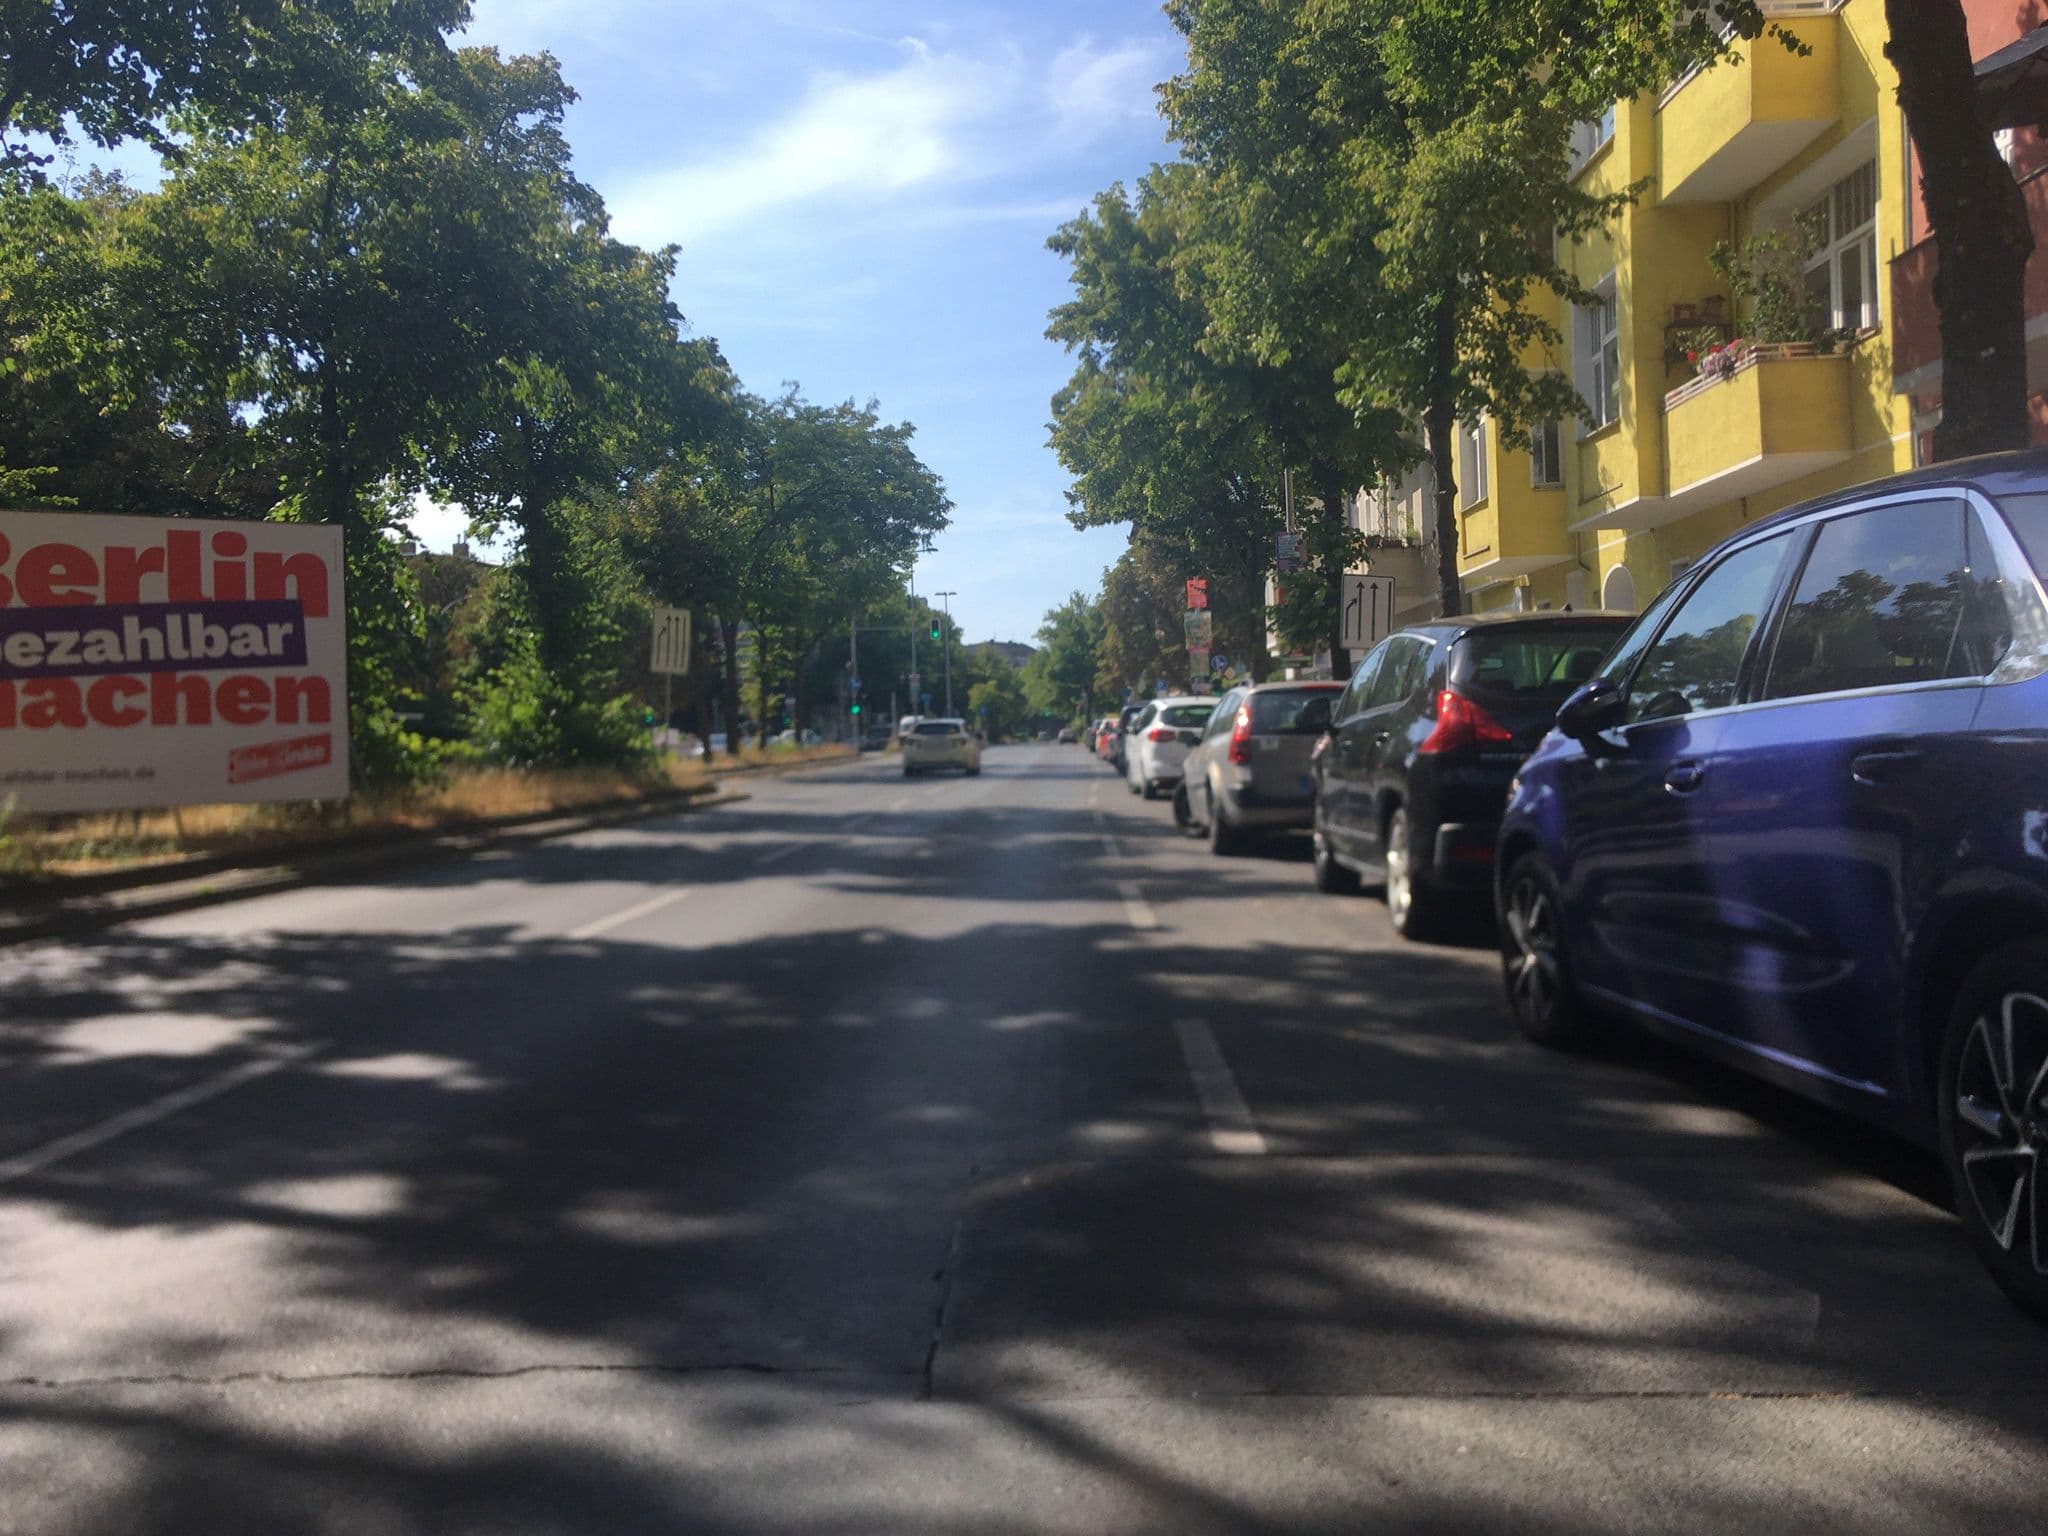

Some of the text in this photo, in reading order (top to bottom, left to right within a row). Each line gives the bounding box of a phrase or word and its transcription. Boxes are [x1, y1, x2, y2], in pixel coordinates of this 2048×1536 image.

[0, 529, 328, 618] erlin
[0, 613, 294, 668] ezahlbar
[0, 671, 331, 729] achen
